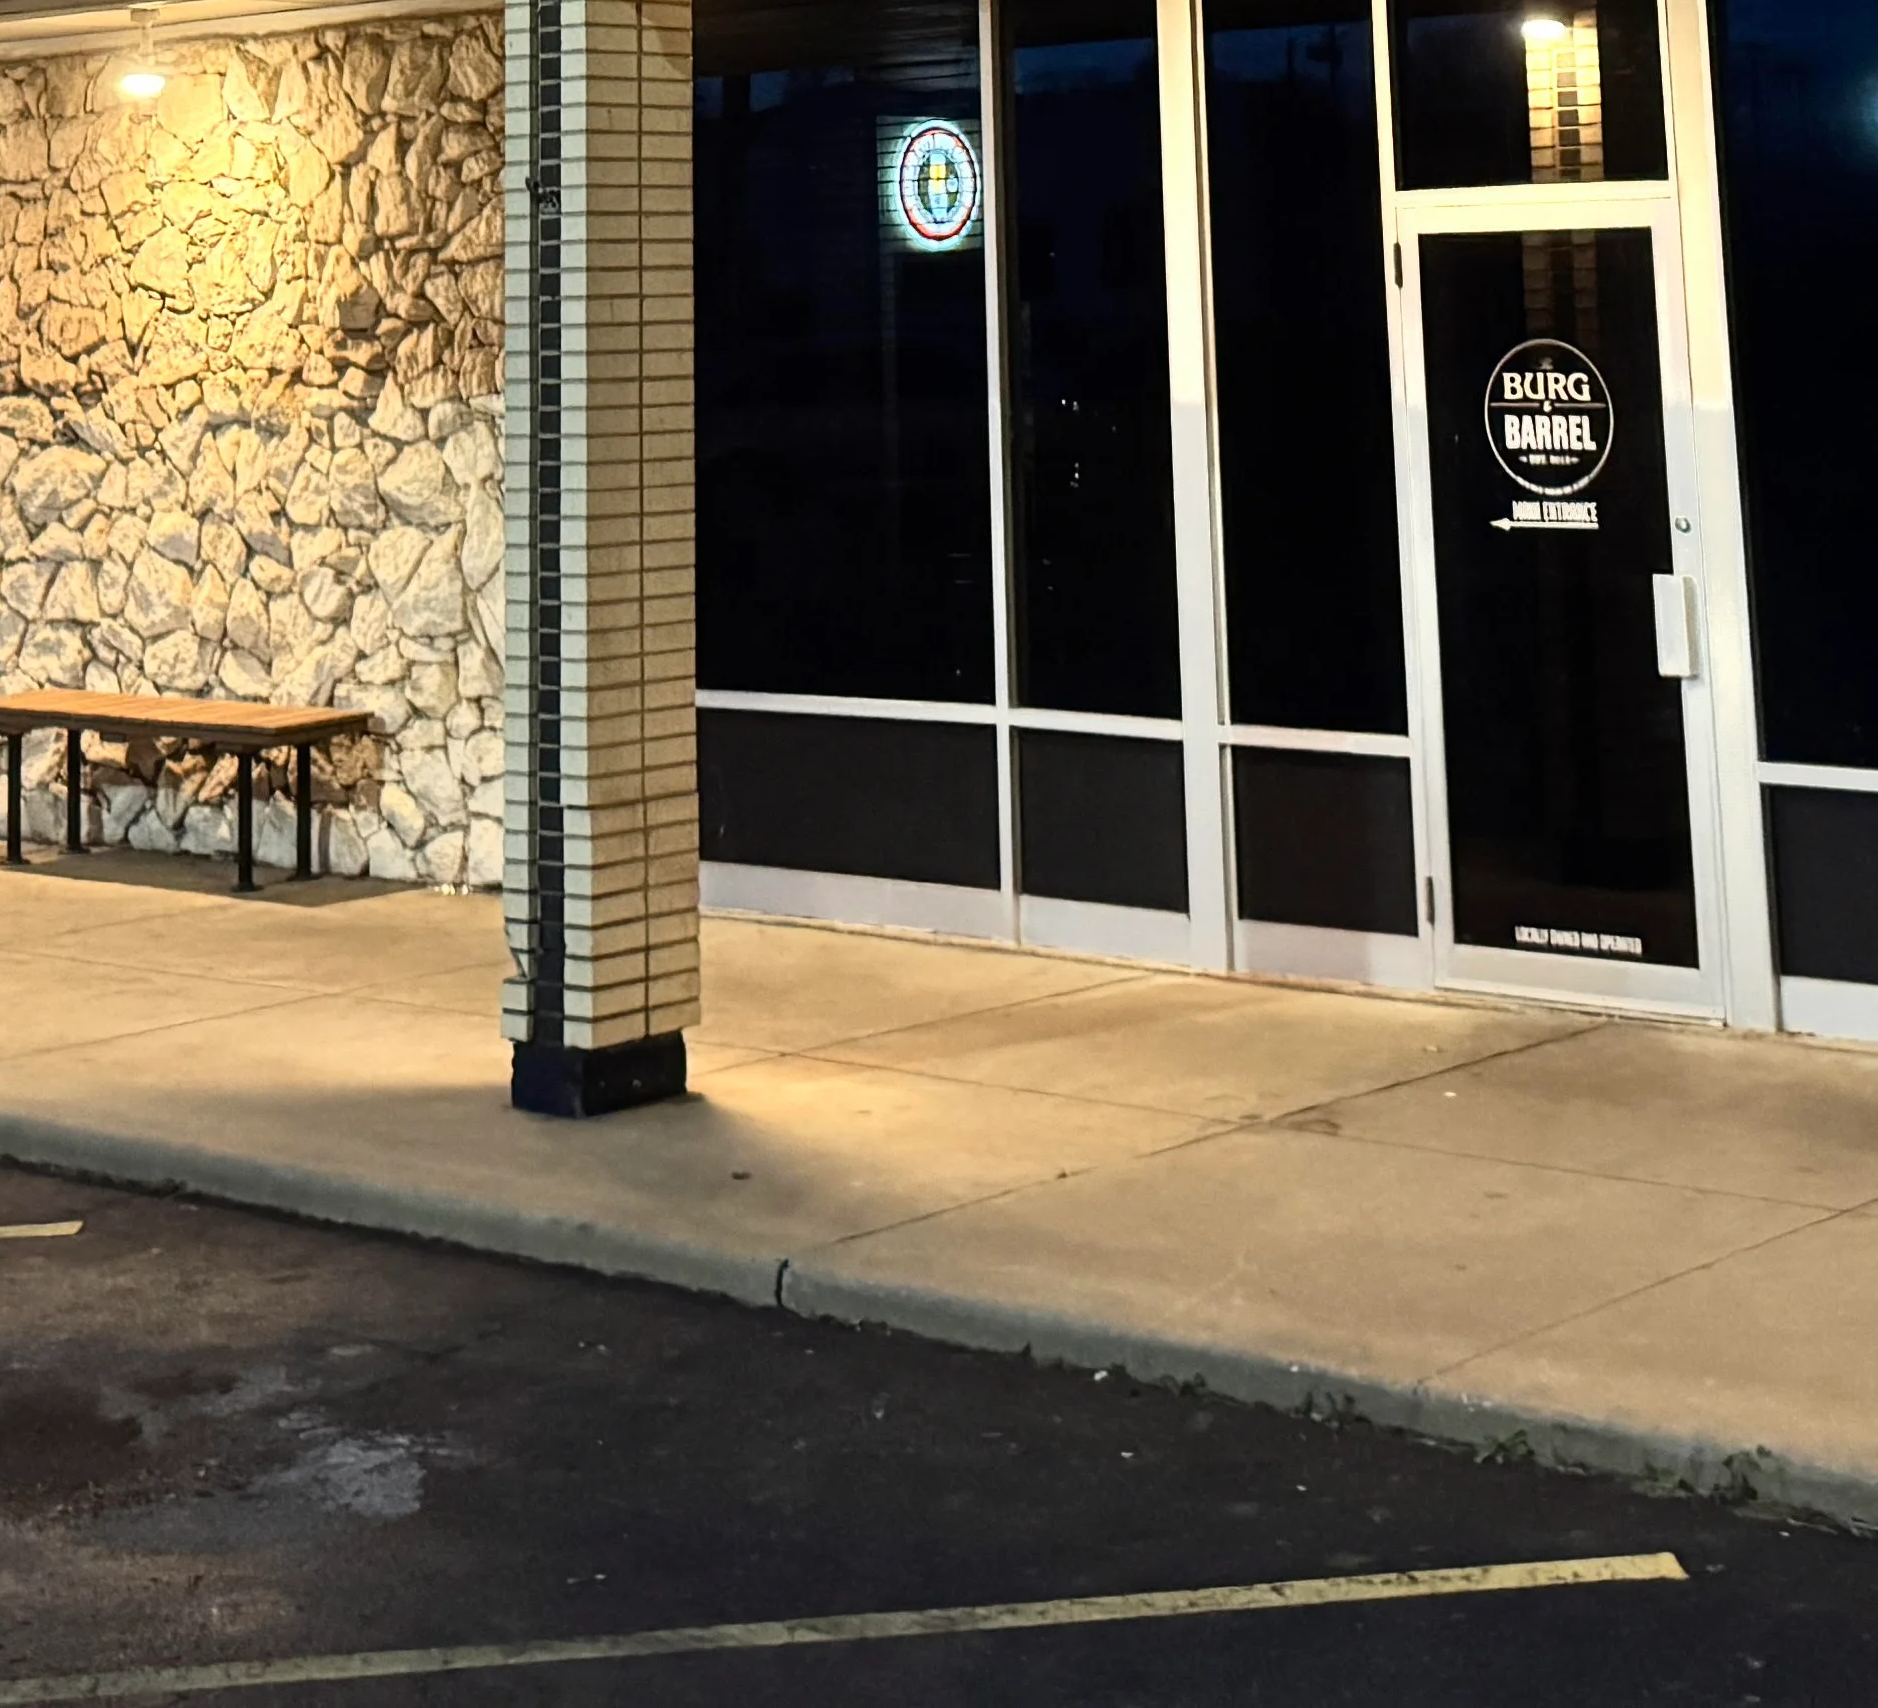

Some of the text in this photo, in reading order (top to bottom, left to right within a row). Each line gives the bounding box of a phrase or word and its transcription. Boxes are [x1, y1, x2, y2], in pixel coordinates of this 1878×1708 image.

[1502, 372, 1591, 401] BURG
[1504, 414, 1597, 451] BARREL
[1542, 500, 1598, 523] ENTRANCE
